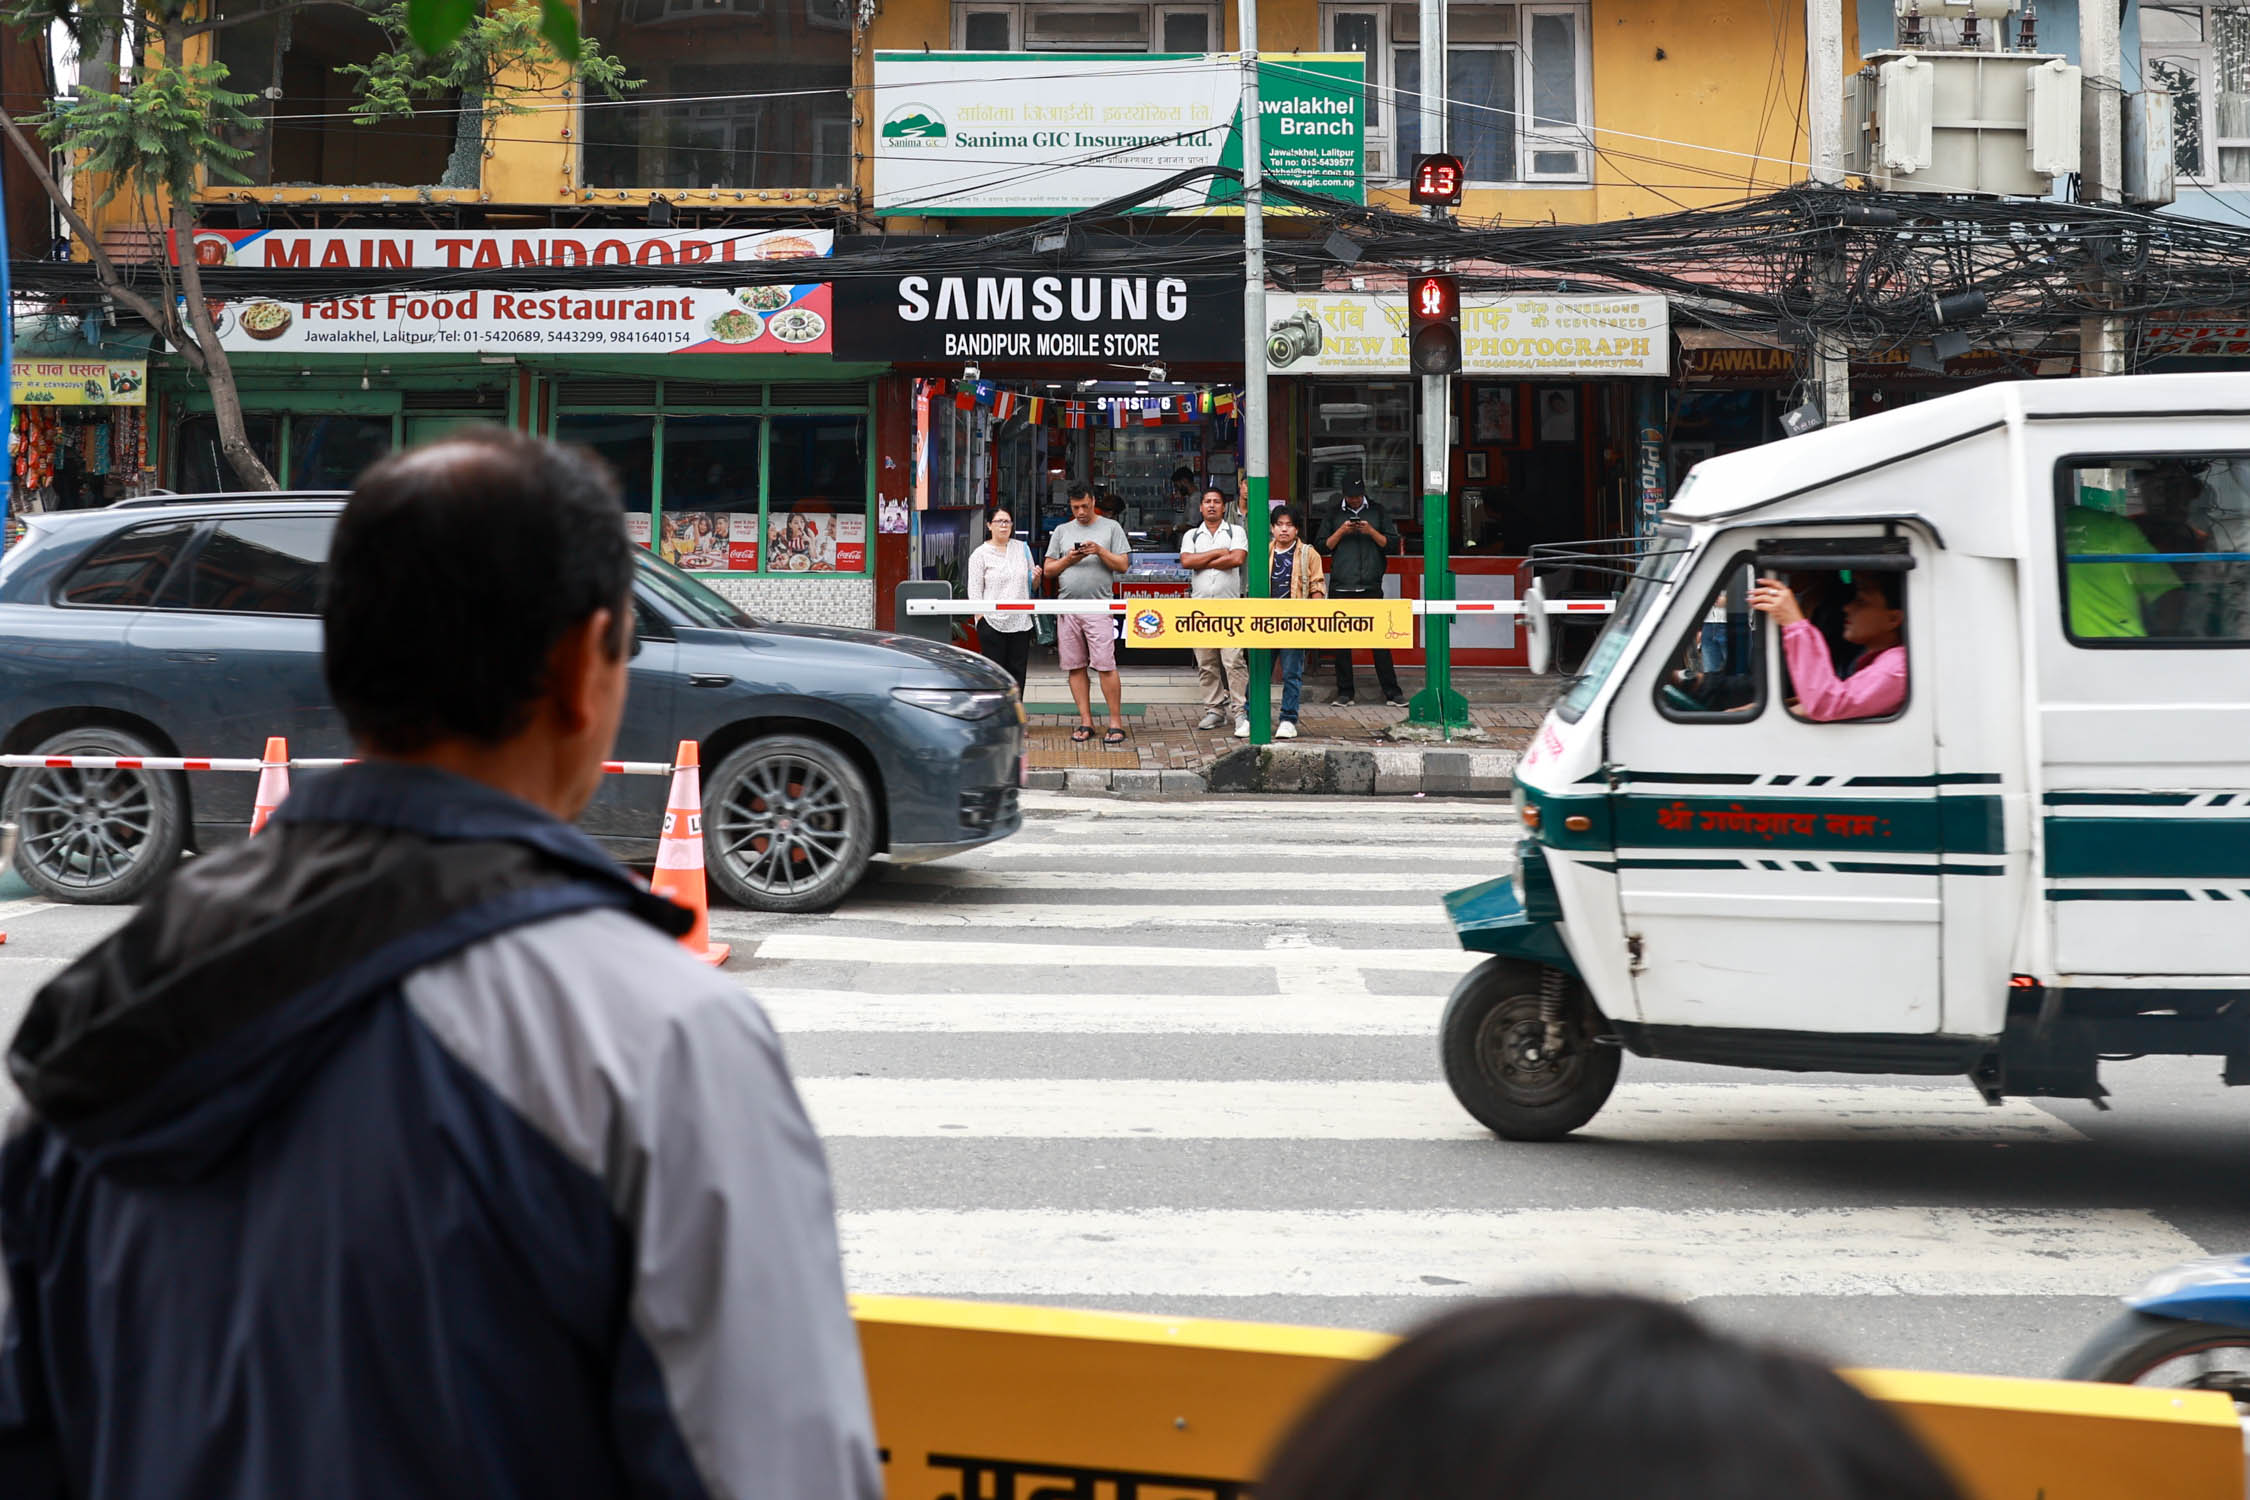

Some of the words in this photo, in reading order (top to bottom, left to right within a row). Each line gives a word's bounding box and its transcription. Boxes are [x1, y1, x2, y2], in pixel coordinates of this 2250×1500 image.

[1240, 97, 1354, 114] awalakhel
[1281, 117, 1354, 135] Branch
[955, 131, 1028, 148] Sanima
[1033, 131, 1070, 148] GIC
[1074, 131, 1169, 147] Insurance
[1175, 131, 1213, 148] Ltd.
[1268, 148, 1319, 157] Jawalakhel,
[1321, 148, 1355, 158] Lalitpur
[1270, 158, 1283, 166] Tel
[1420, 166, 1455, 194] 13
[264, 239, 414, 268] MAIN
[388, 291, 478, 319] Food
[493, 293, 695, 320] Restaurant
[899, 276, 1188, 322] SAMSUNG
[304, 330, 379, 344] Jawalakhel,
[383, 331, 436, 345] Lalitpur,
[439, 331, 461, 342] Tel:
[463, 331, 543, 344] 01-5420689,
[547, 331, 606, 344] 5443299,
[610, 332, 690, 343] 9841640154
[945, 334, 1030, 356] BANDIPUR
[1037, 334, 1099, 356] MOBILE
[1104, 334, 1159, 356] STORE
[1323, 337, 1384, 355] NEW
[1464, 337, 1650, 356] PHOTOGRAPH
[37, 363, 64, 376] पान
[69, 363, 107, 376] पसल
[1175, 610, 1245, 637] ललितपुर
[1251, 610, 1374, 633] महानगरपालिका
